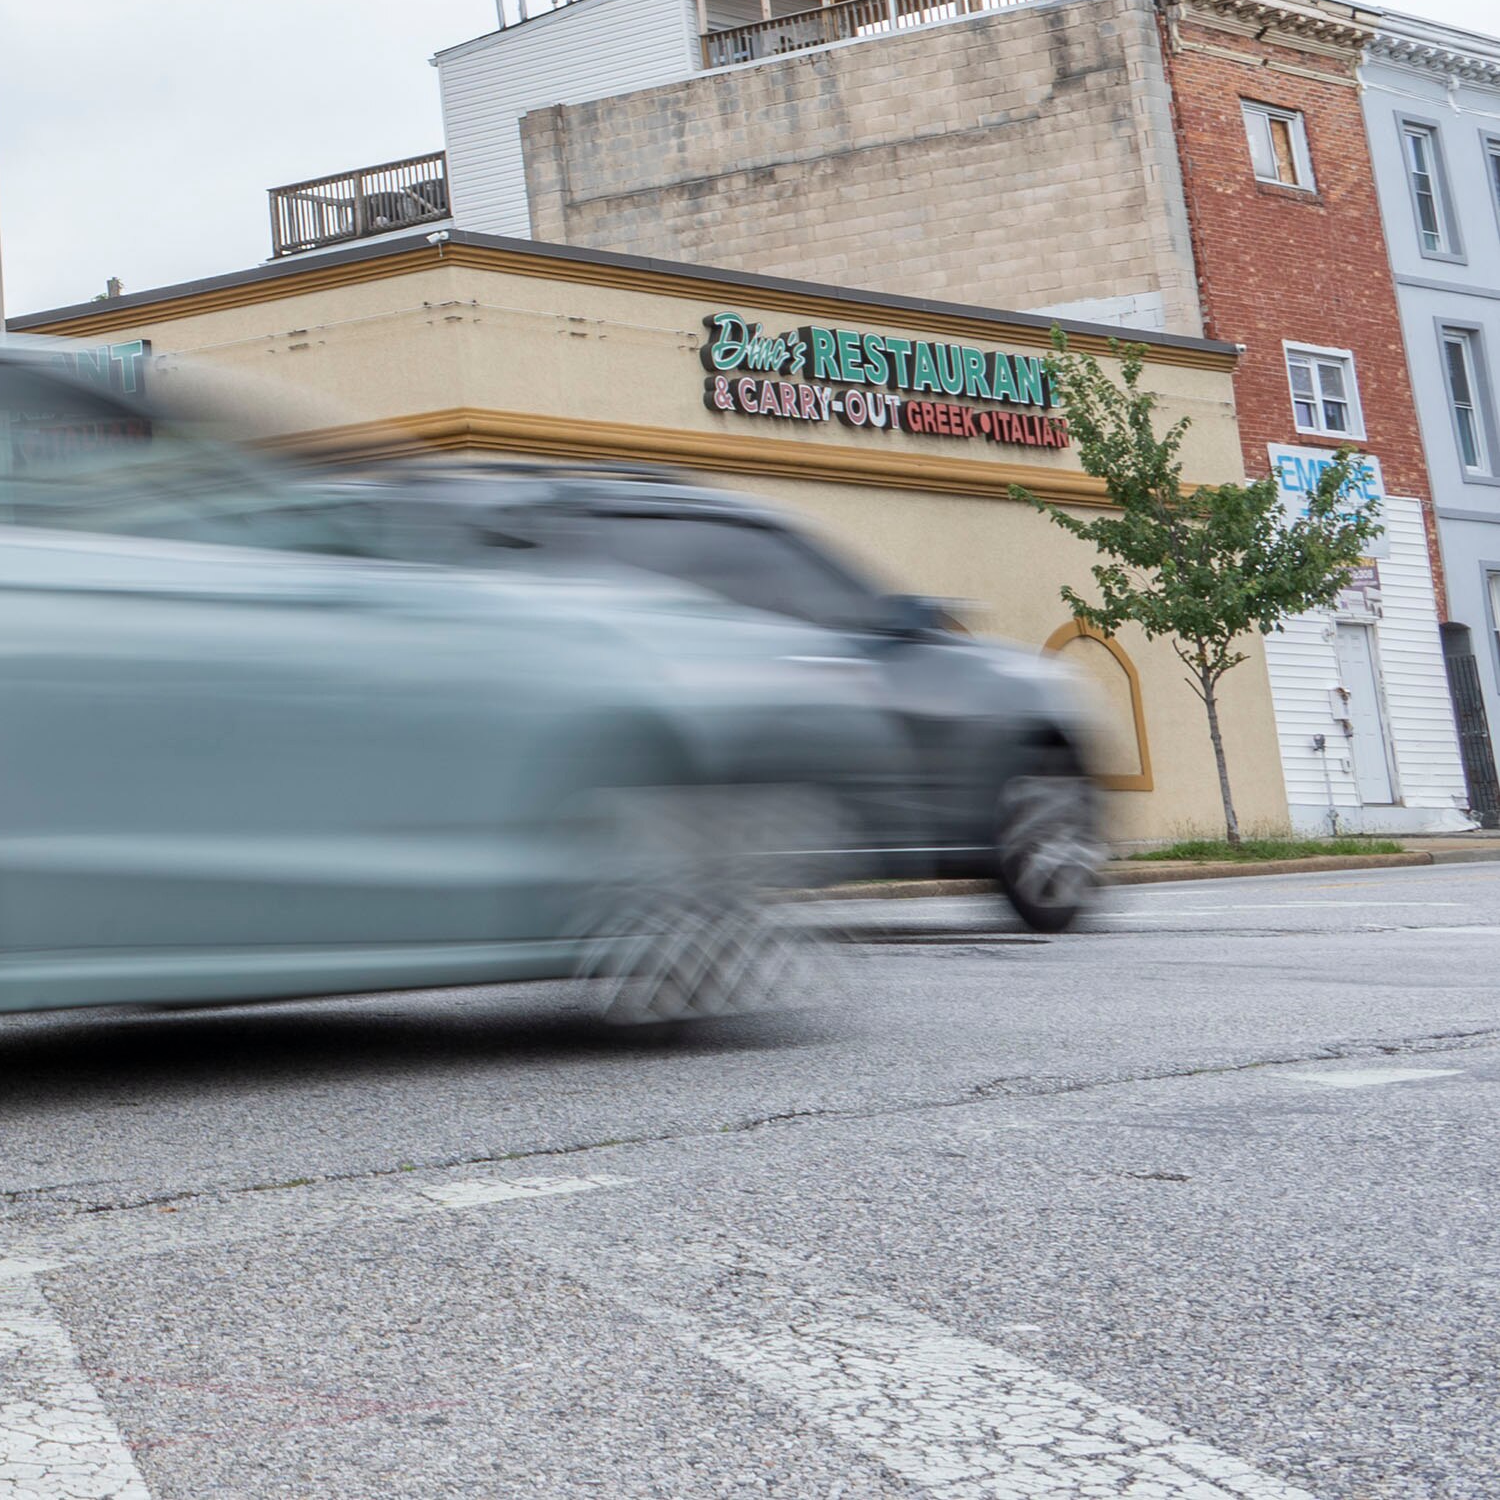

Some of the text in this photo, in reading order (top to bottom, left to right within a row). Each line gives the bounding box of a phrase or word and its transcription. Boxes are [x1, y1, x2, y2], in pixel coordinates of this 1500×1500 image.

[711, 311, 1064, 408] Dino's RESTAURANT
[713, 375, 1070, 448] & CARRY-OUT GREEK ITALIAN
